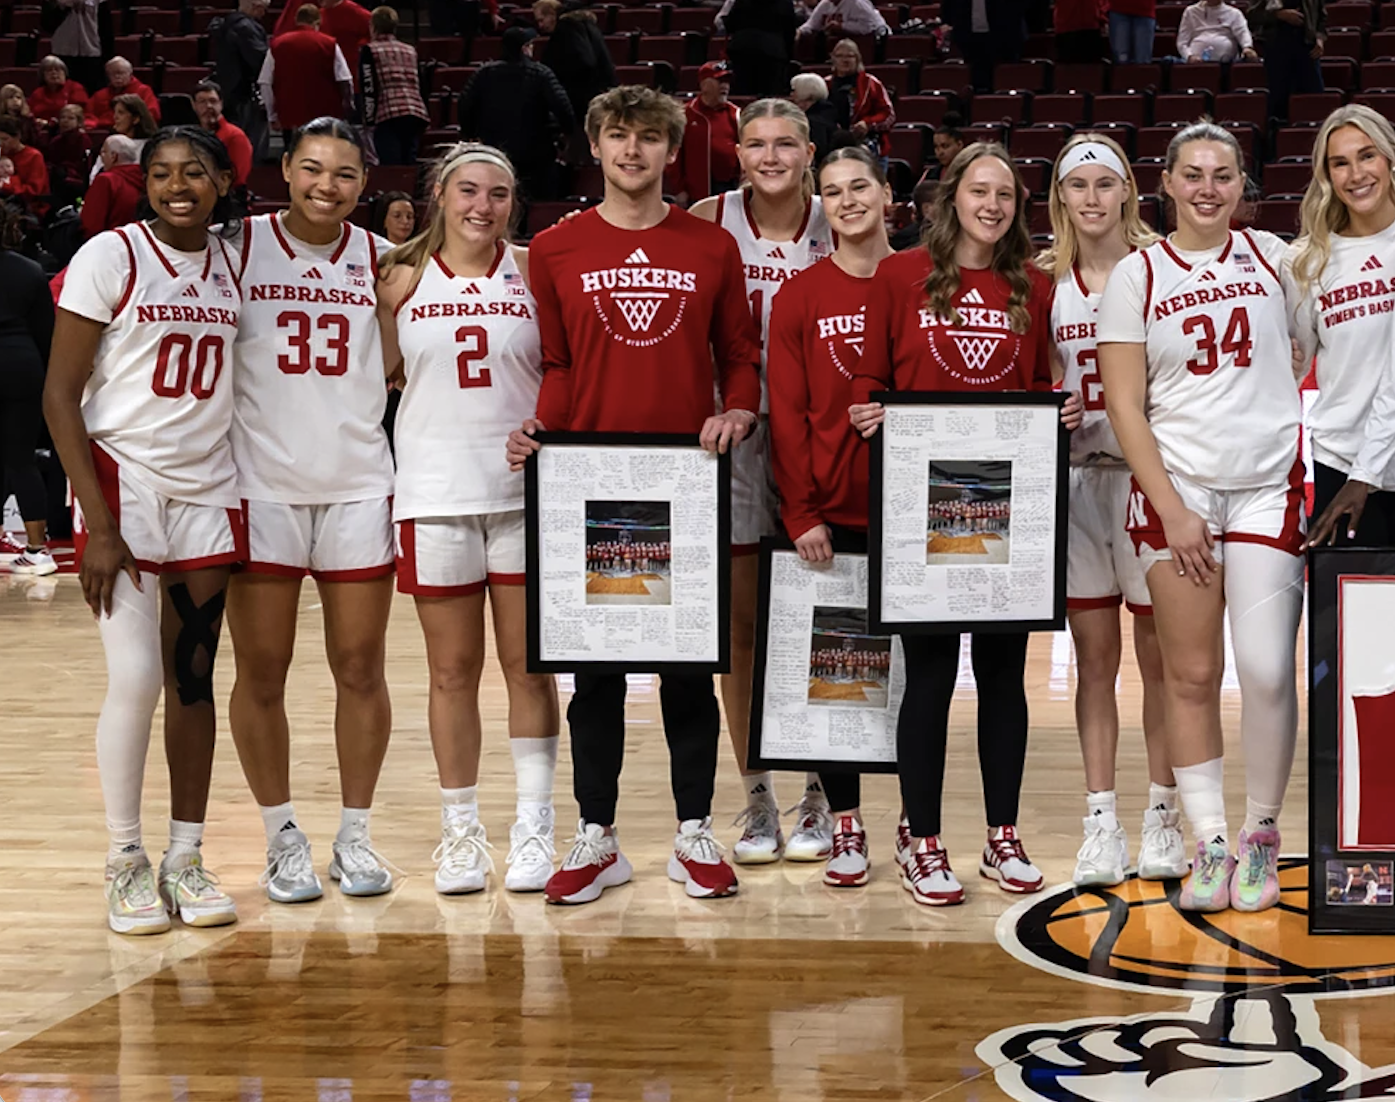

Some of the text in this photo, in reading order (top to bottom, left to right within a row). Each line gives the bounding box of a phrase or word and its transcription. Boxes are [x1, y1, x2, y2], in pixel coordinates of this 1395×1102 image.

[249, 284, 376, 307] NEBRASKA
[580, 268, 697, 293] HUSKERS
[410, 302, 533, 322] NEBRASKA
[1154, 281, 1269, 321] NEBRASKA
[276, 311, 351, 377] 33
[455, 325, 492, 389] 2
[1181, 306, 1253, 376] 34
[151, 332, 224, 400] 00
[1127, 490, 1149, 529] N
